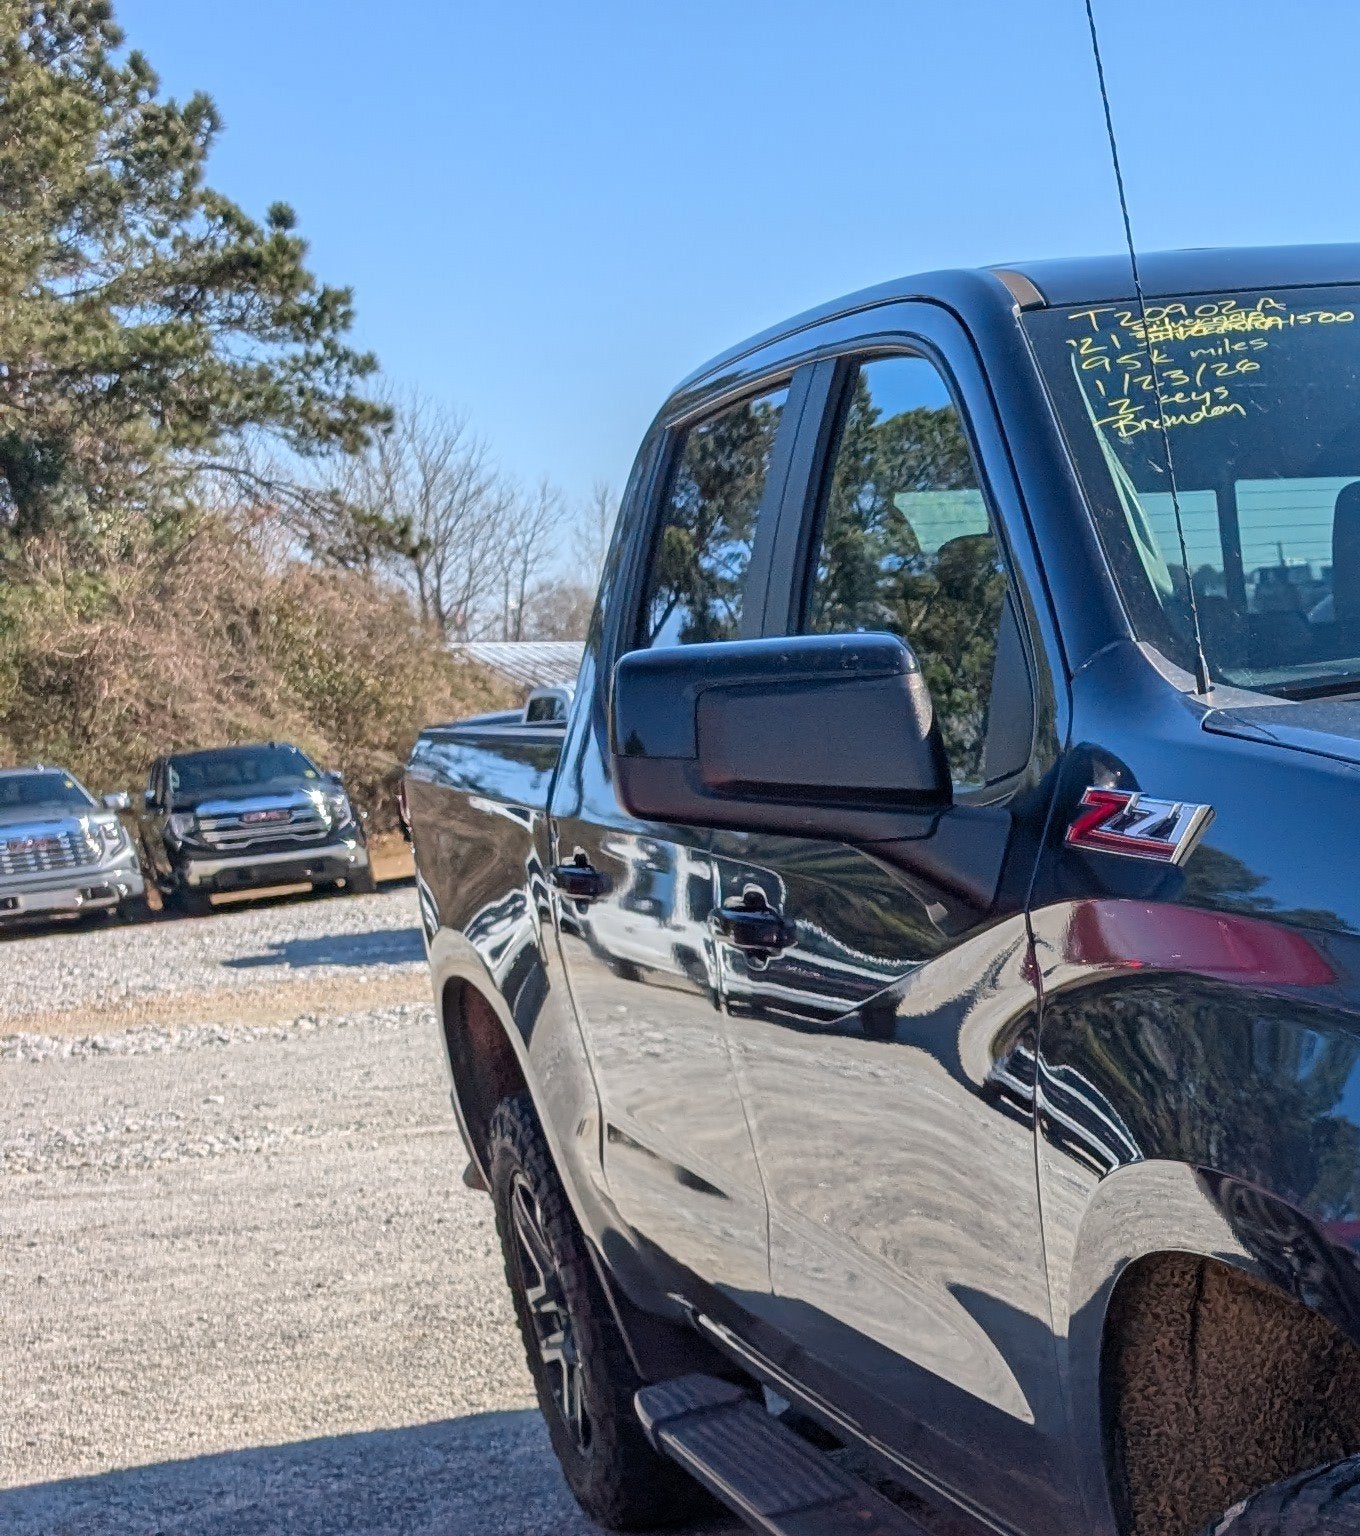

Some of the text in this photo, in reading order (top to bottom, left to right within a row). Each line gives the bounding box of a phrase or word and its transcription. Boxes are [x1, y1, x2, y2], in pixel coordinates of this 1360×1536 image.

[1289, 310, 1355, 327] 1500
[1189, 337, 1269, 358] miles
[1065, 786, 1218, 868] Z71
